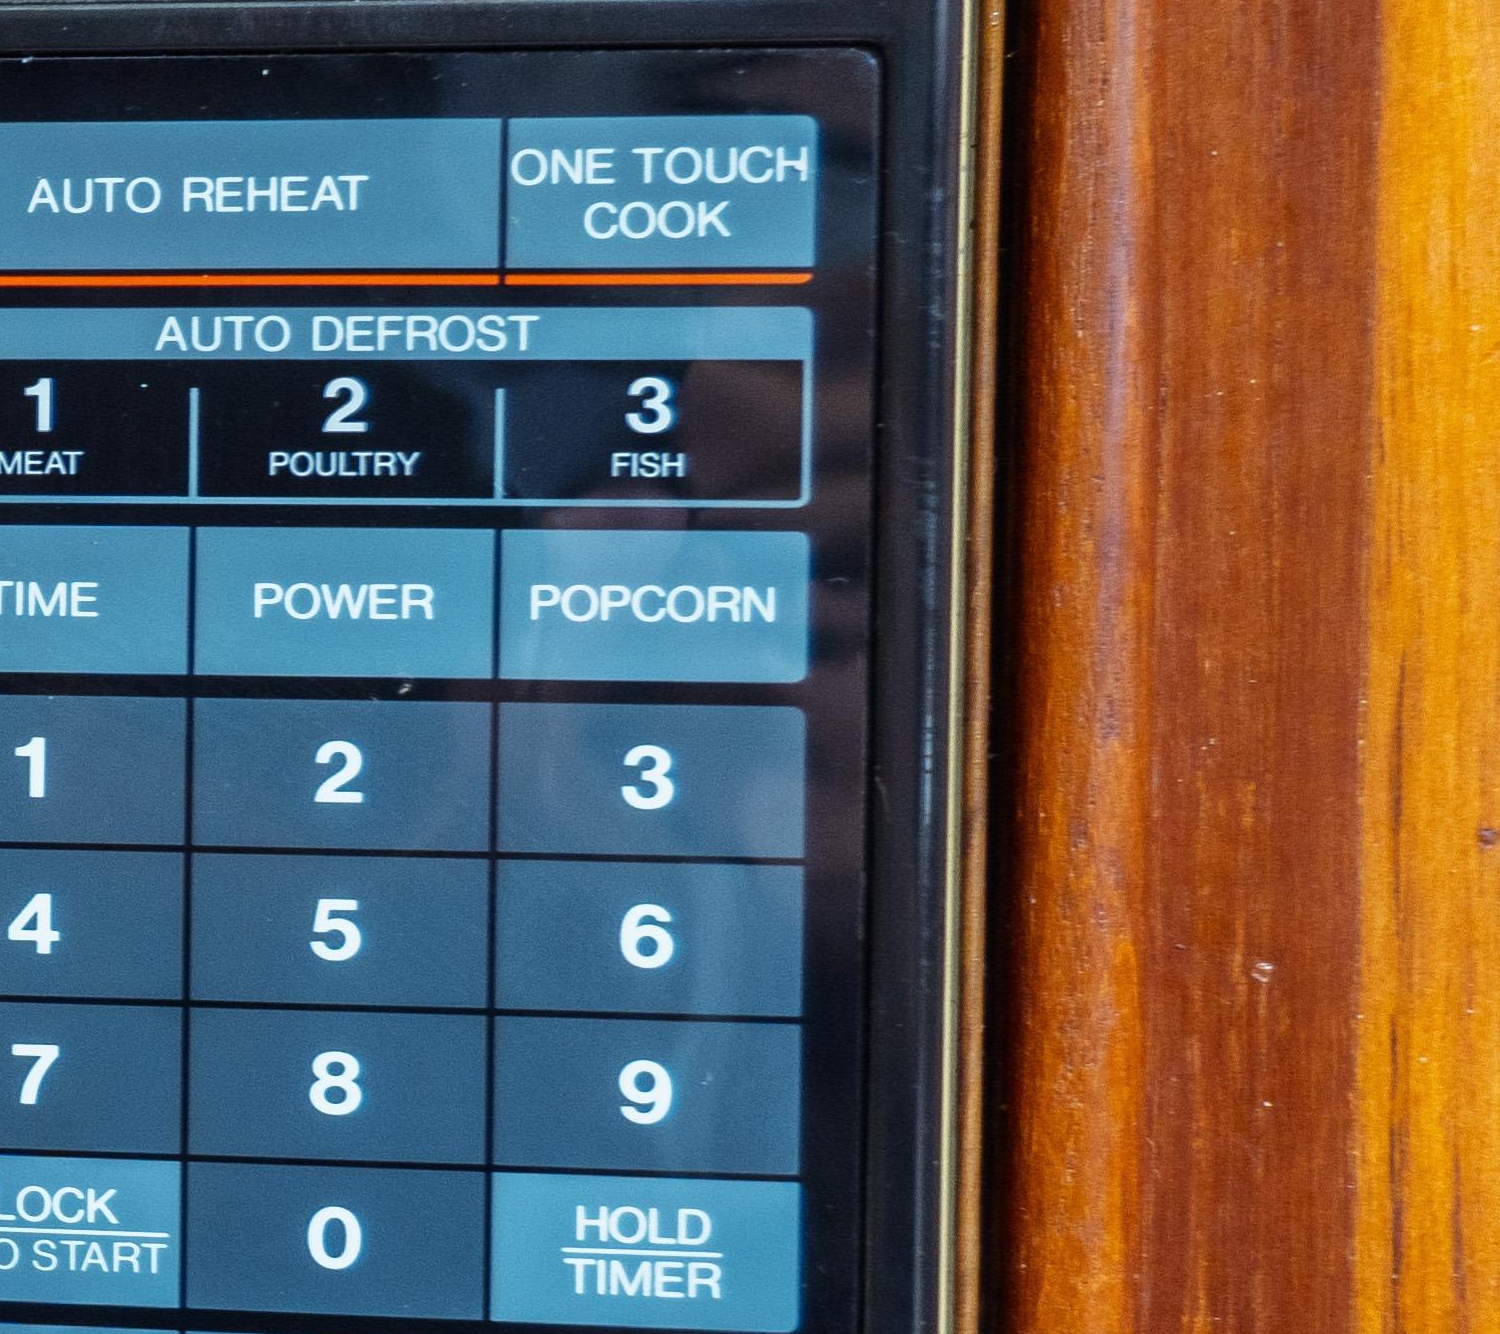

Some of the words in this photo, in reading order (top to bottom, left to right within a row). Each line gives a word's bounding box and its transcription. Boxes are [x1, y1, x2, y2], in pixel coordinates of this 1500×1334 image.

[511, 149, 615, 186] ONE
[632, 146, 809, 185] TOUCH
[26, 177, 162, 214] AUTO
[183, 175, 369, 213] REHEAT
[583, 201, 731, 239] COOK
[155, 315, 290, 353] AUTO
[312, 314, 540, 353] DEFROST
[22, 378, 55, 432] 1
[322, 378, 369, 433] 2
[625, 378, 675, 435] 3
[269, 452, 420, 478] POULTRY
[611, 453, 685, 478] FISH
[253, 584, 434, 621] POWER
[530, 586, 776, 624] POPCORN
[14, 737, 47, 797] 1
[313, 740, 364, 803] 2
[621, 744, 674, 809] 3
[7, 894, 60, 954] 4
[308, 898, 362, 961] 5
[619, 904, 674, 969] 6
[11, 1044, 60, 1105] 7
[308, 1051, 362, 1115] 8
[618, 1061, 672, 1125] 9
[307, 1206, 362, 1269] 0
[576, 1205, 712, 1245] HOLD
[31, 1239, 167, 1274] START
[563, 1259, 722, 1299] TIMER
